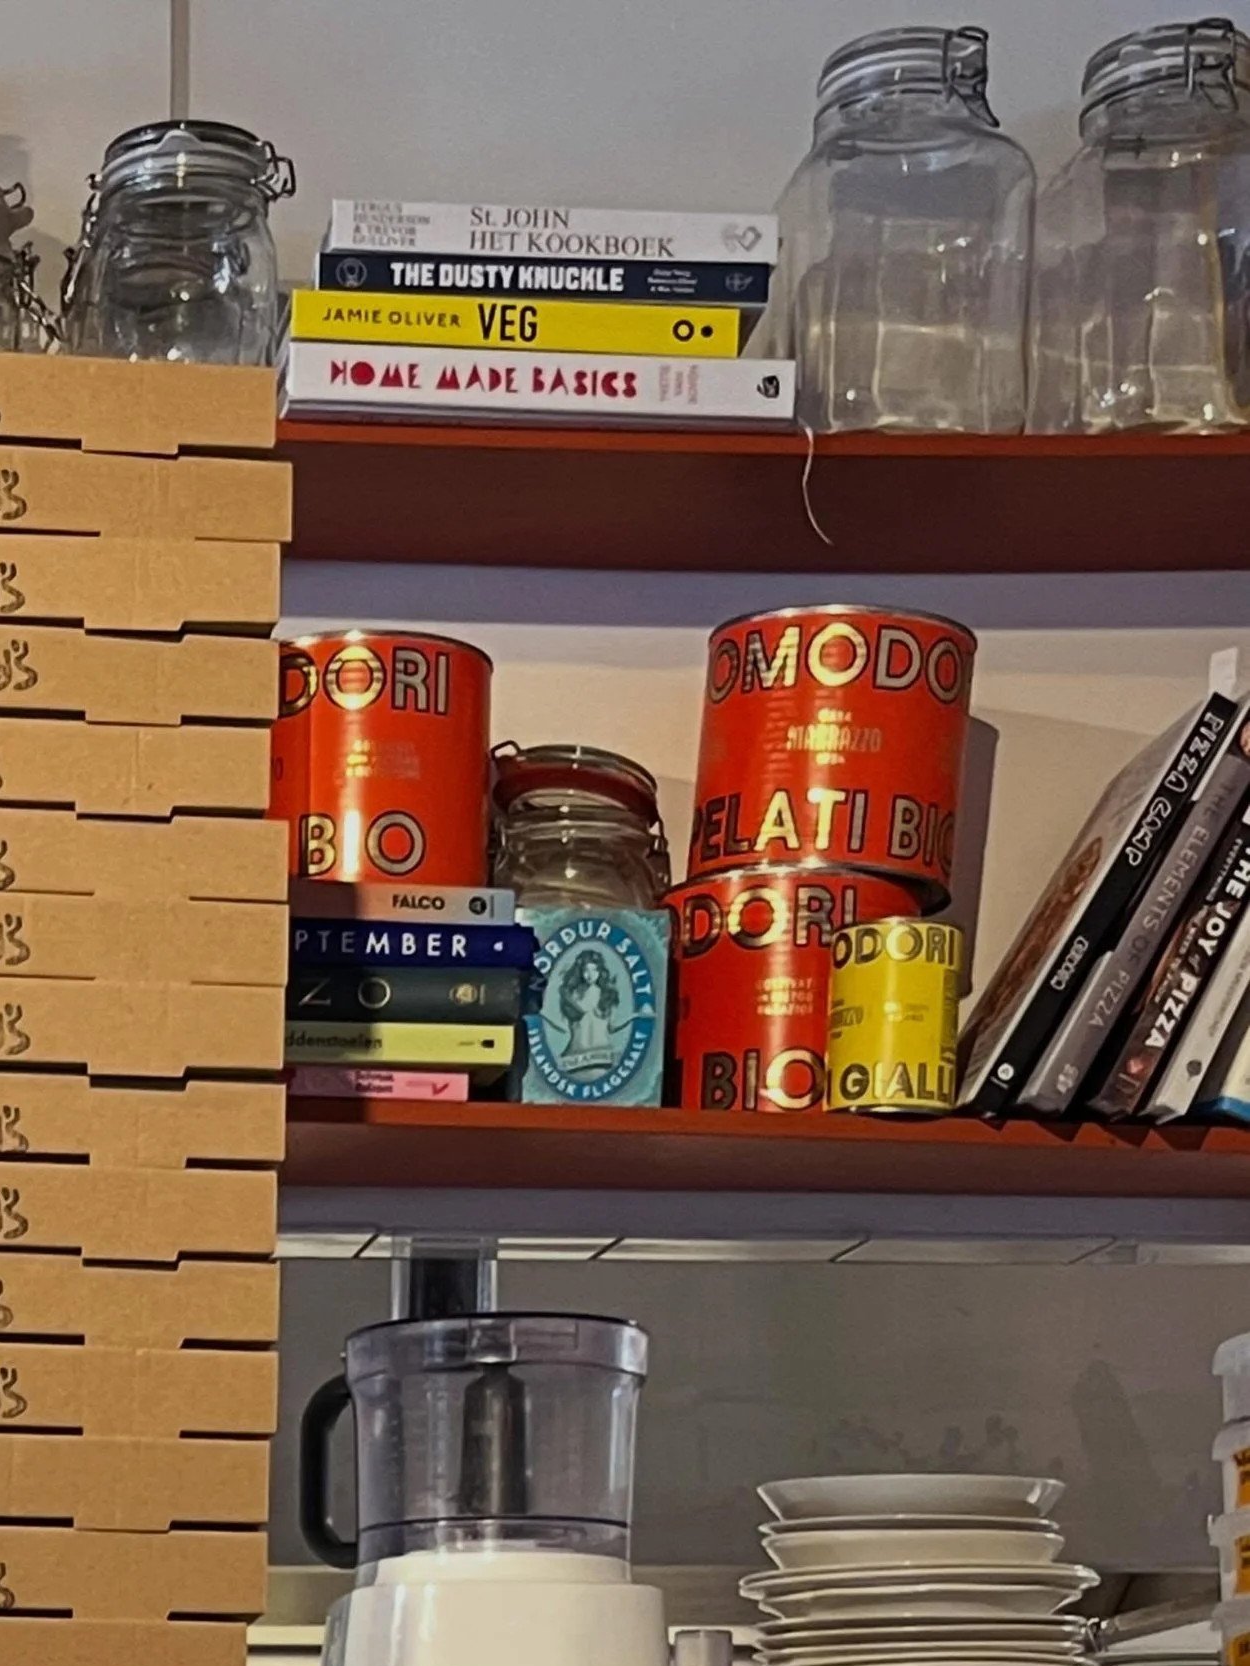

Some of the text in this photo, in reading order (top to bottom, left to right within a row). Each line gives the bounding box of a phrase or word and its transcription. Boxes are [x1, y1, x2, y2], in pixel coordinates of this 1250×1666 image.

[469, 230, 675, 258] HET KOOKBOEK
[502, 208, 571, 229] JOHN
[390, 261, 435, 287] THE
[438, 263, 514, 290] DUSTY
[517, 265, 625, 292] KNUCKLE
[323, 303, 539, 343] JAMIE OLIVER VEG
[330, 359, 421, 390] HOME
[435, 362, 519, 395] MADE
[532, 365, 638, 399] BASICS
[279, 643, 450, 719] DORI
[707, 621, 963, 705] OMODO
[299, 809, 427, 878] BIO
[392, 894, 445, 911] FALCO
[1143, 824, 1210, 930] ELEMENTS
[294, 929, 468, 957] PTEMBER
[832, 924, 956, 969] ODORI
[1197, 901, 1232, 956] JOY
[616, 937, 652, 995] SALT
[1088, 969, 1131, 1029] PIZZA
[1145, 970, 1199, 1048] PIZZA
[701, 1046, 828, 1111] BIO
